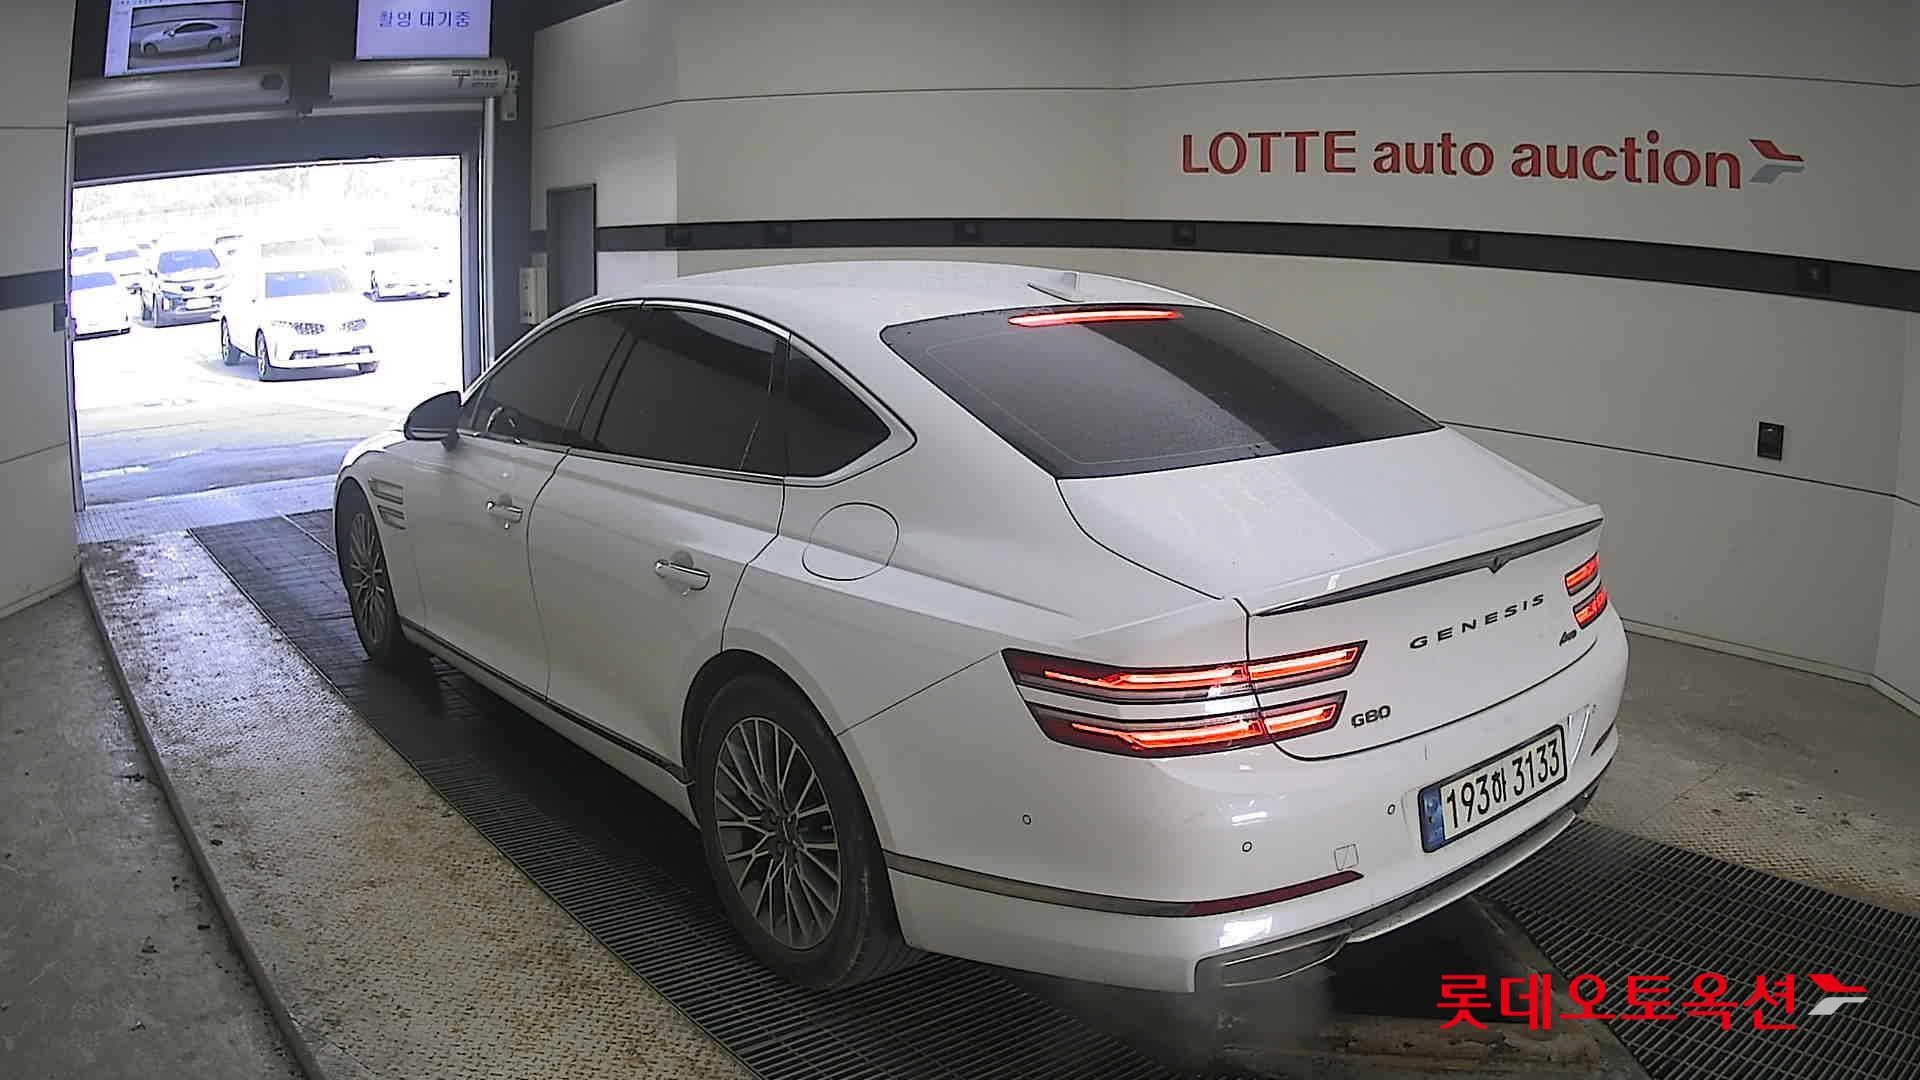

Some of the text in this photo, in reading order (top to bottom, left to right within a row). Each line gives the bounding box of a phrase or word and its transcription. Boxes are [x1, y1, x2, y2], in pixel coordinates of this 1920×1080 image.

[419, 10, 471, 28] 대기중
[1182, 129, 1741, 189] LOTTE auto auction
[1409, 594, 1544, 649] GENESIS
[1350, 705, 1391, 728] G80
[1446, 738, 1560, 829] 193하 3133
